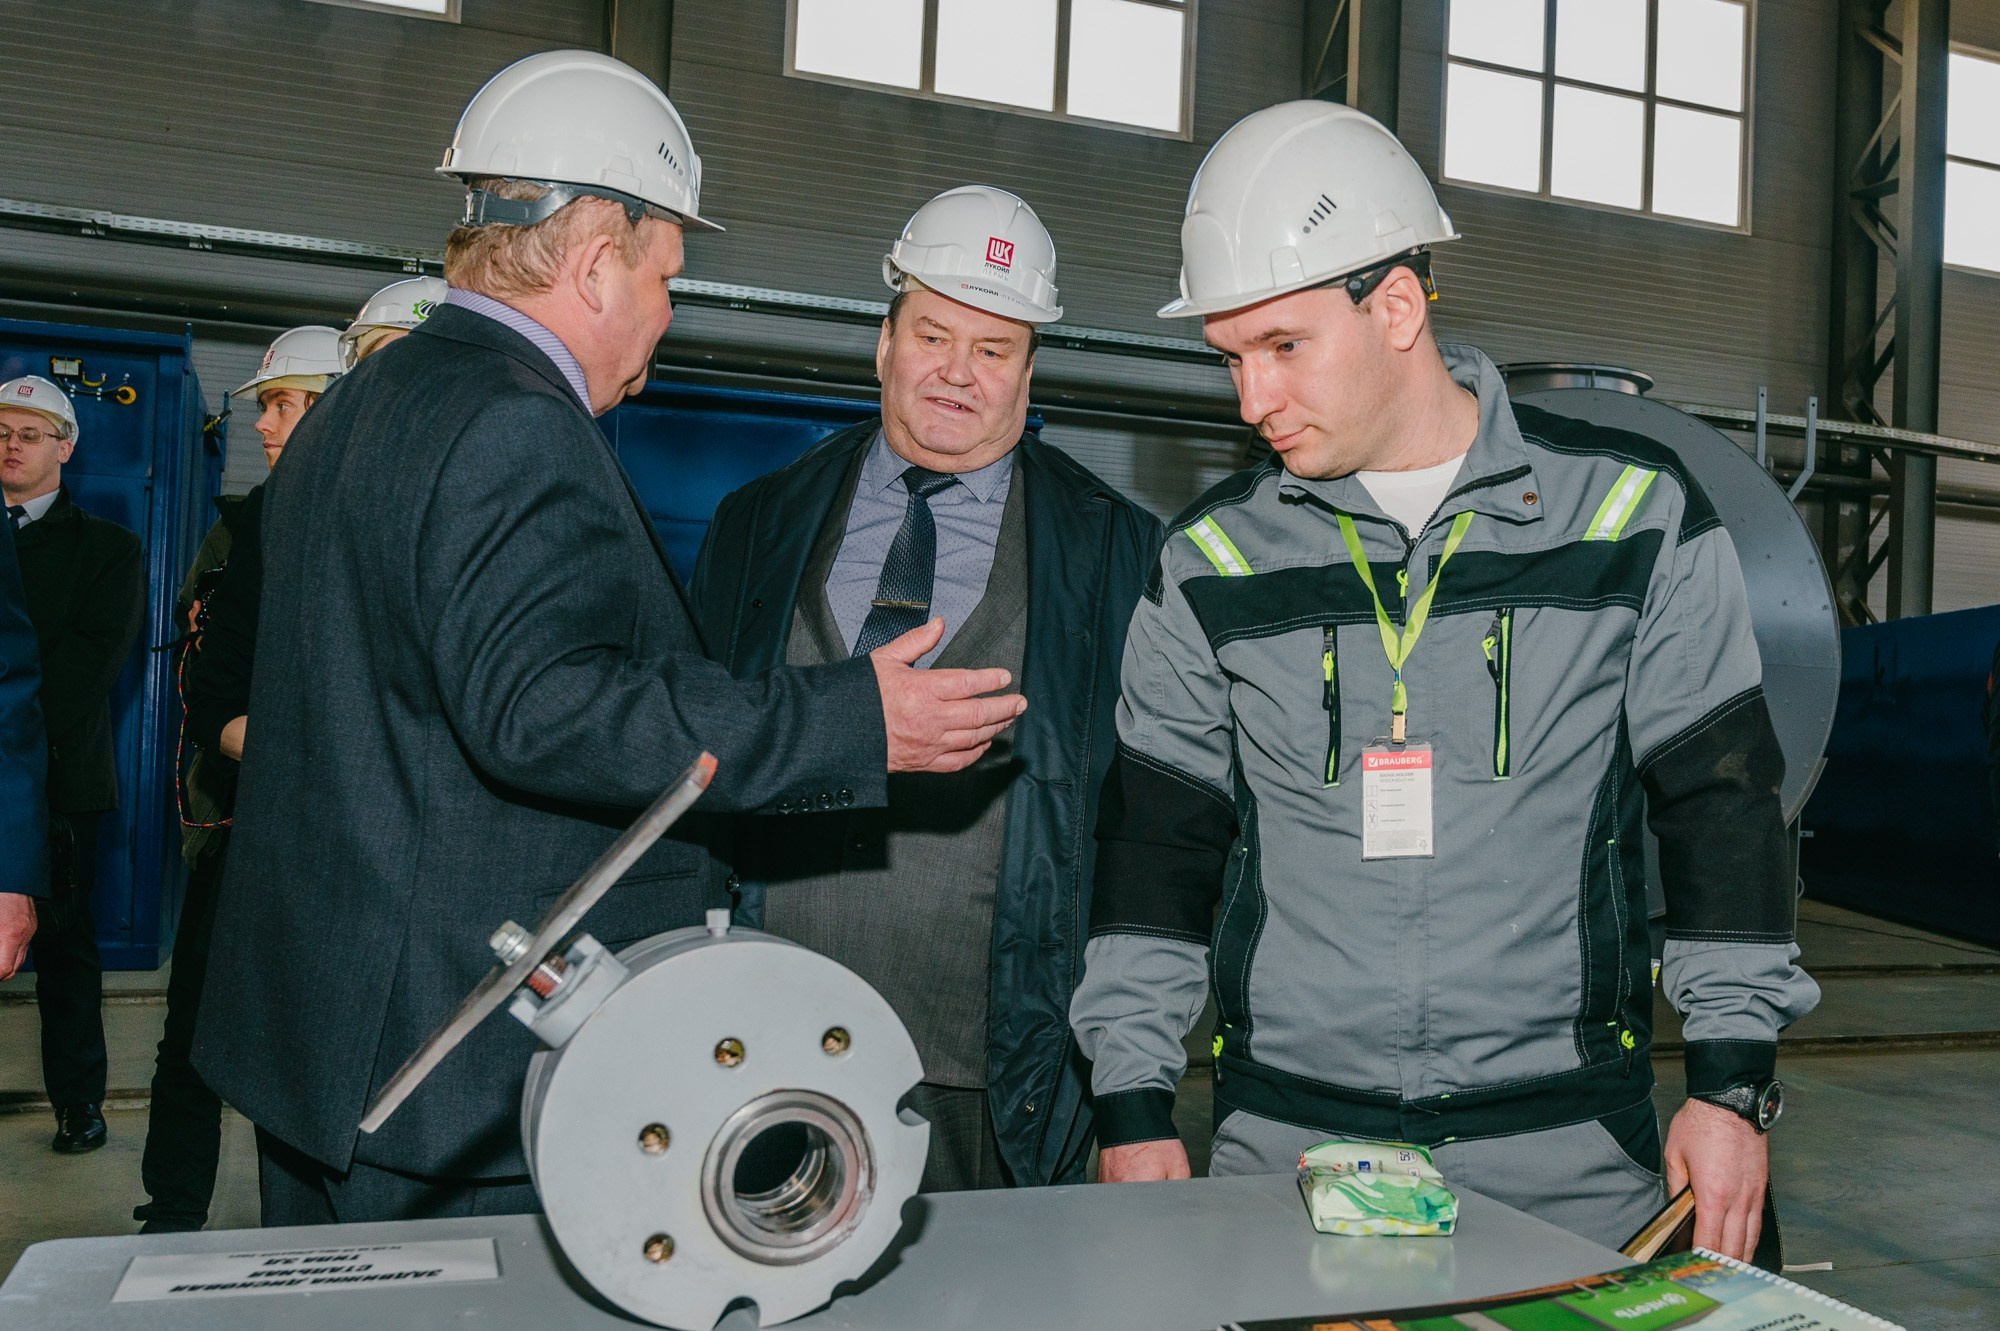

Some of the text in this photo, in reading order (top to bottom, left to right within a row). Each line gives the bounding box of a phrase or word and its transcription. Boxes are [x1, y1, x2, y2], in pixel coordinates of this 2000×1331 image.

[1378, 756, 1423, 766] BRAUBERG
[302, 1254, 361, 1263] ТИПА
[247, 1264, 373, 1278] СТАЛЬНАЯ
[169, 1268, 443, 1292] ЗАДВИЖКА ДИСКОВАЯ
